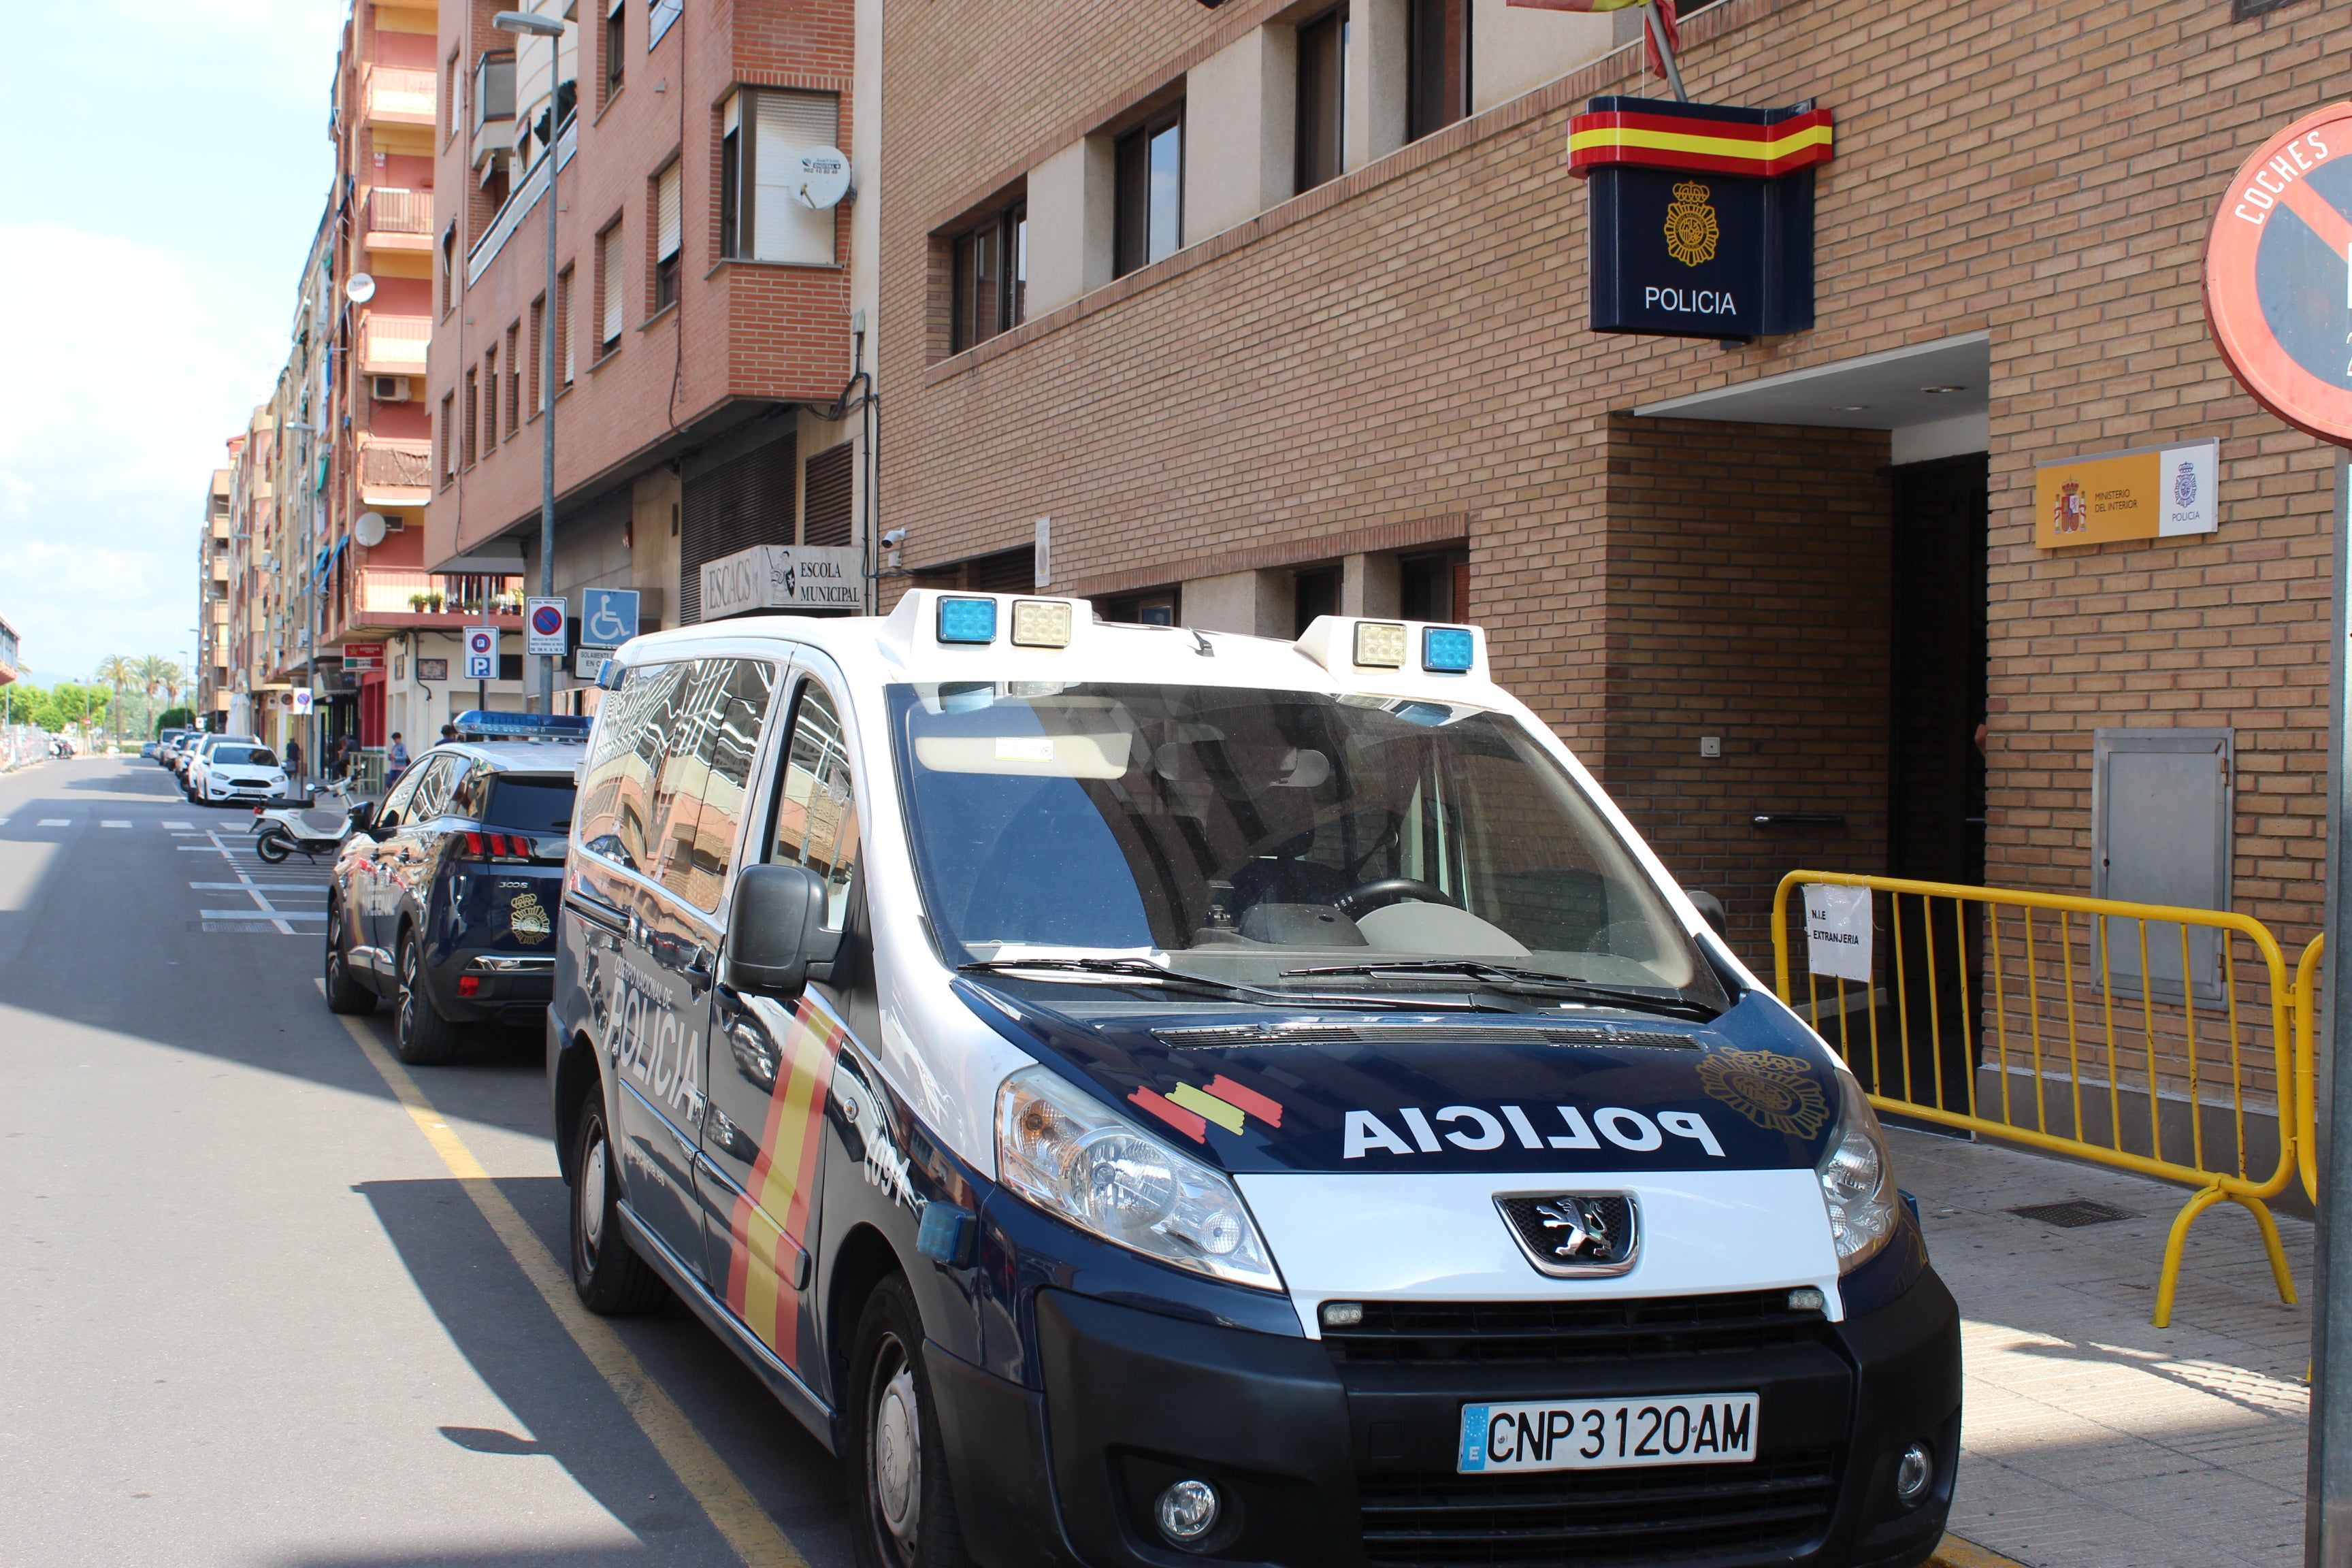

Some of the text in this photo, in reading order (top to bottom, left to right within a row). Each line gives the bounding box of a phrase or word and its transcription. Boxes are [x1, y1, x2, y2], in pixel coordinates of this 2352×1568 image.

[2234, 130, 2329, 225] COCHES
[1645, 286, 1737, 316] POLICIA
[2094, 488, 2131, 502] MINISTERIO
[2094, 499, 2138, 513] DEL INTERIOR
[2172, 511, 2200, 522] POLICIA
[800, 562, 842, 578] ESCOLA
[708, 559, 750, 610] ESCACS
[800, 586, 860, 602] MUNICIPAL
[1813, 930, 1859, 945] EXTRANJERIA
[615, 956, 673, 1011] CUERPO NACIONAL DE
[603, 977, 699, 1122] POLICIA
[1469, 1446, 1481, 1461] E
